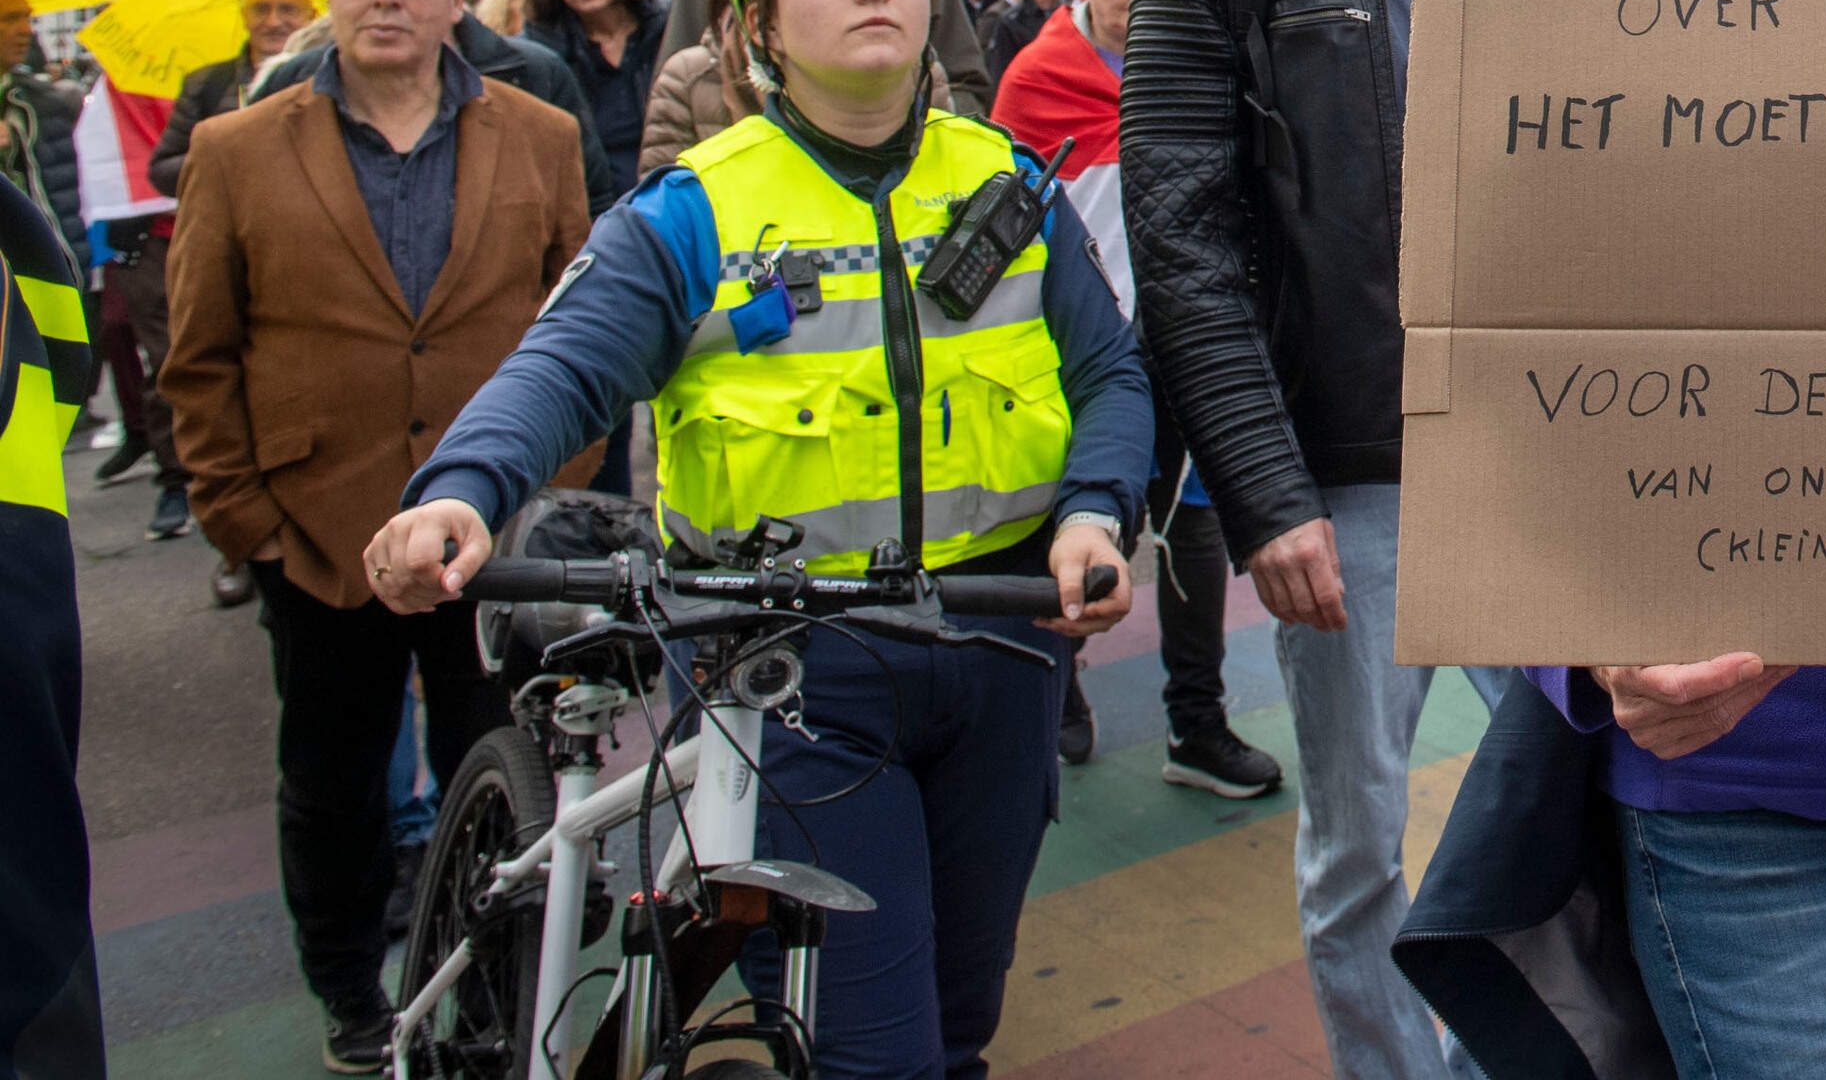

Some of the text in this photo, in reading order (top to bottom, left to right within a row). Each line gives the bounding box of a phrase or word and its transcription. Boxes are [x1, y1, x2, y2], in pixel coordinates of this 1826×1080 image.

[1505, 92, 1626, 156] HET
[1525, 362, 1711, 424] VOOR
[1626, 463, 1713, 500] VAN
